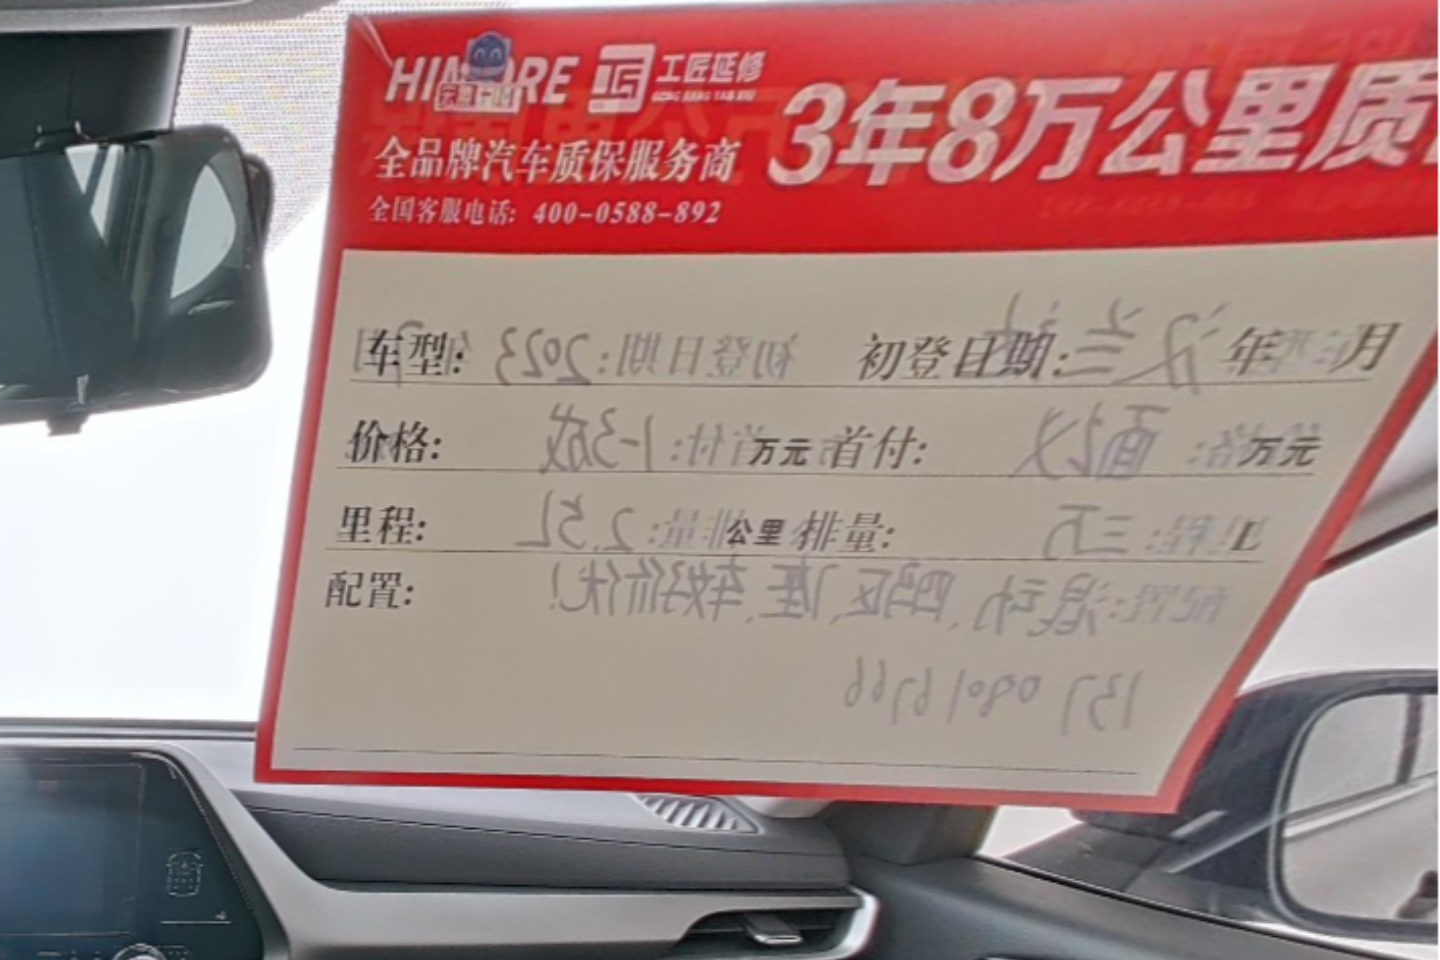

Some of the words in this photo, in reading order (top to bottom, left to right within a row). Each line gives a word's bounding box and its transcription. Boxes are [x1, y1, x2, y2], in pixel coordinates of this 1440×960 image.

[656, 49, 766, 84] 工匠延修
[766, 58, 1440, 187] 3年8万公里质
[375, 136, 742, 185] 全品牌汽车质保服务商
[533, 200, 722, 225] 400-0588-892
[362, 328, 463, 377] 车型:
[1227, 325, 1283, 377] 年
[1329, 321, 1401, 371] 月
[349, 419, 442, 466] 价格:
[747, 437, 811, 467] 万元
[828, 425, 928, 470] 首付:
[1237, 437, 1322, 468] 万元
[335, 504, 427, 545] 里程:
[726, 518, 785, 548] 公里
[798, 510, 896, 555] 排量:
[325, 570, 414, 610] 配置:
